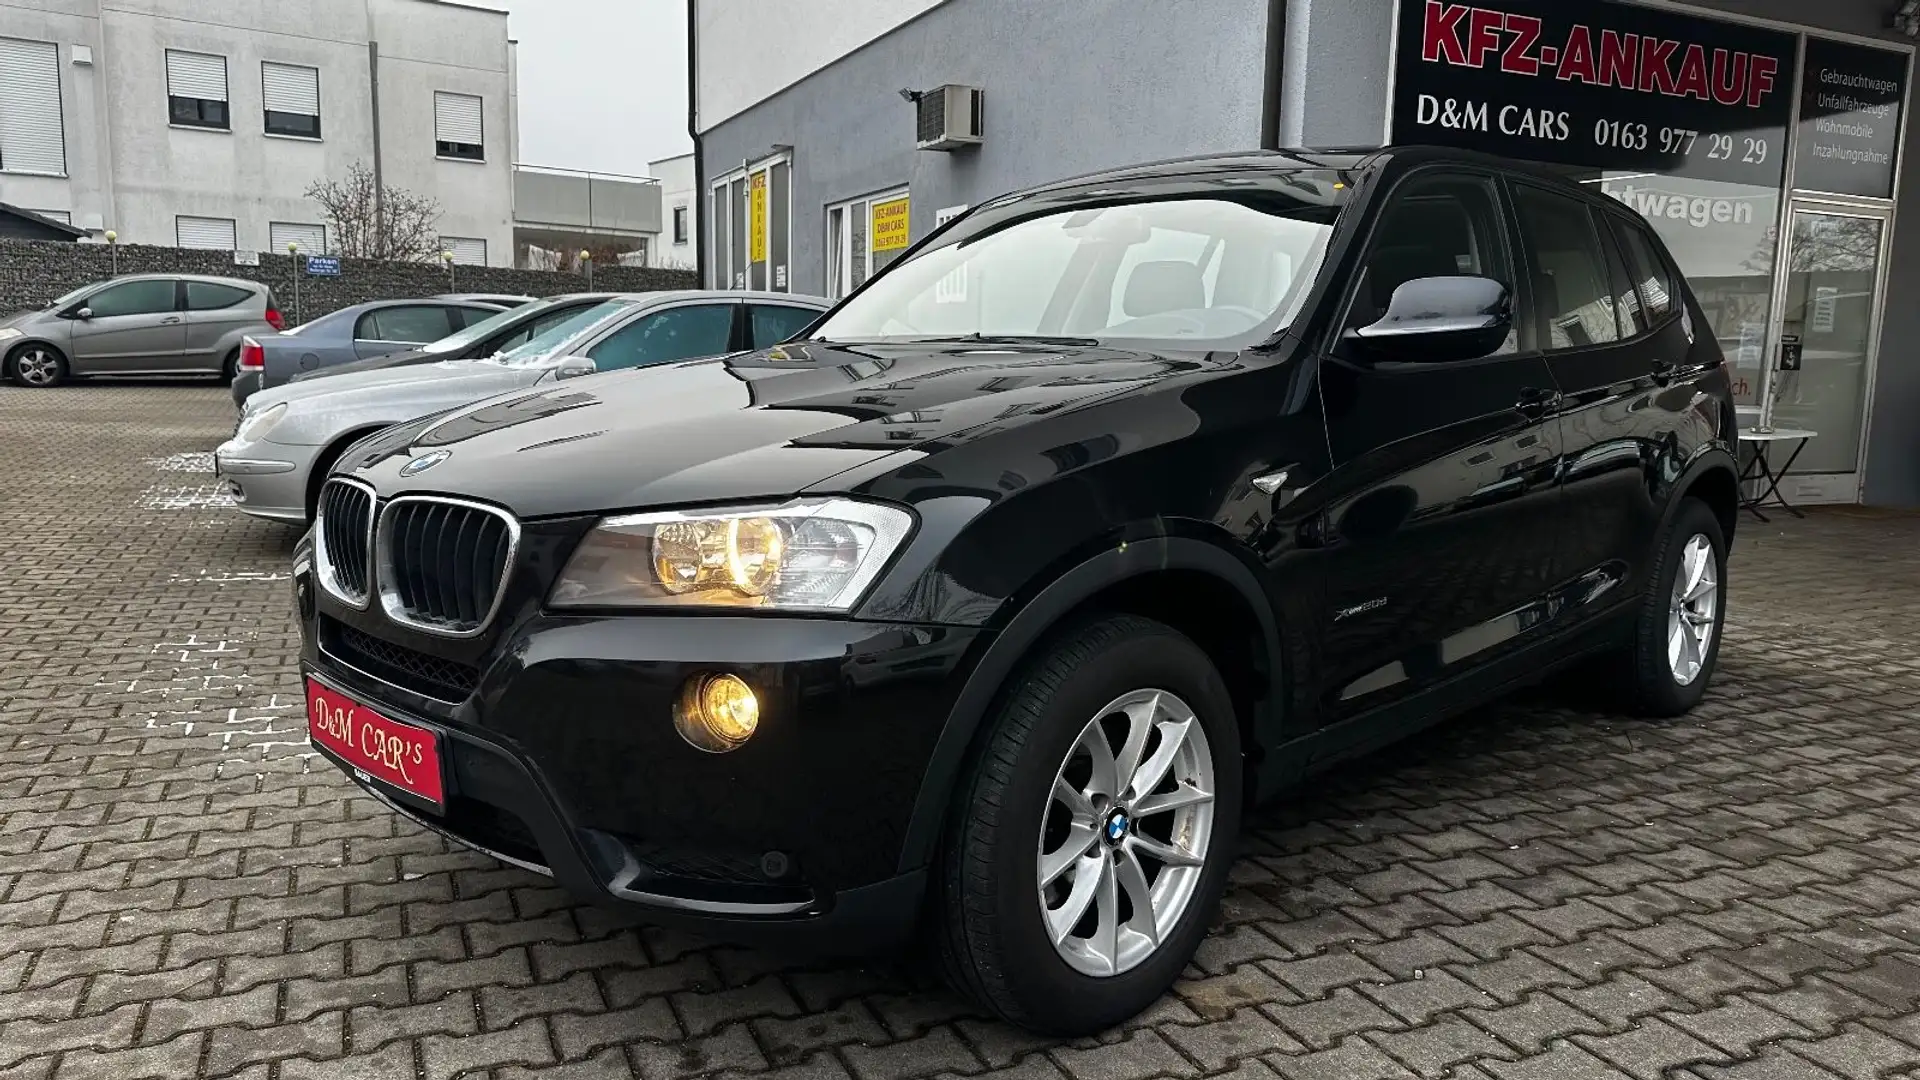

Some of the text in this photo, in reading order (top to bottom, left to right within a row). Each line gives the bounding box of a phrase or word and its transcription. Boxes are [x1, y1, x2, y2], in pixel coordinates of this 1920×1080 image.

[1422, 1, 1778, 107] KFZ-ANKAUF
[1820, 68, 1898, 94] Gebrauchtwagen
[1817, 93, 1889, 118] Unfallfahrzeuge
[1417, 94, 1767, 164] D&M CARS 0163 977 29 29
[1815, 117, 1874, 138] Wohnmobile
[1812, 142, 1888, 164] Inzahlungnahme
[315, 697, 354, 747] D&M
